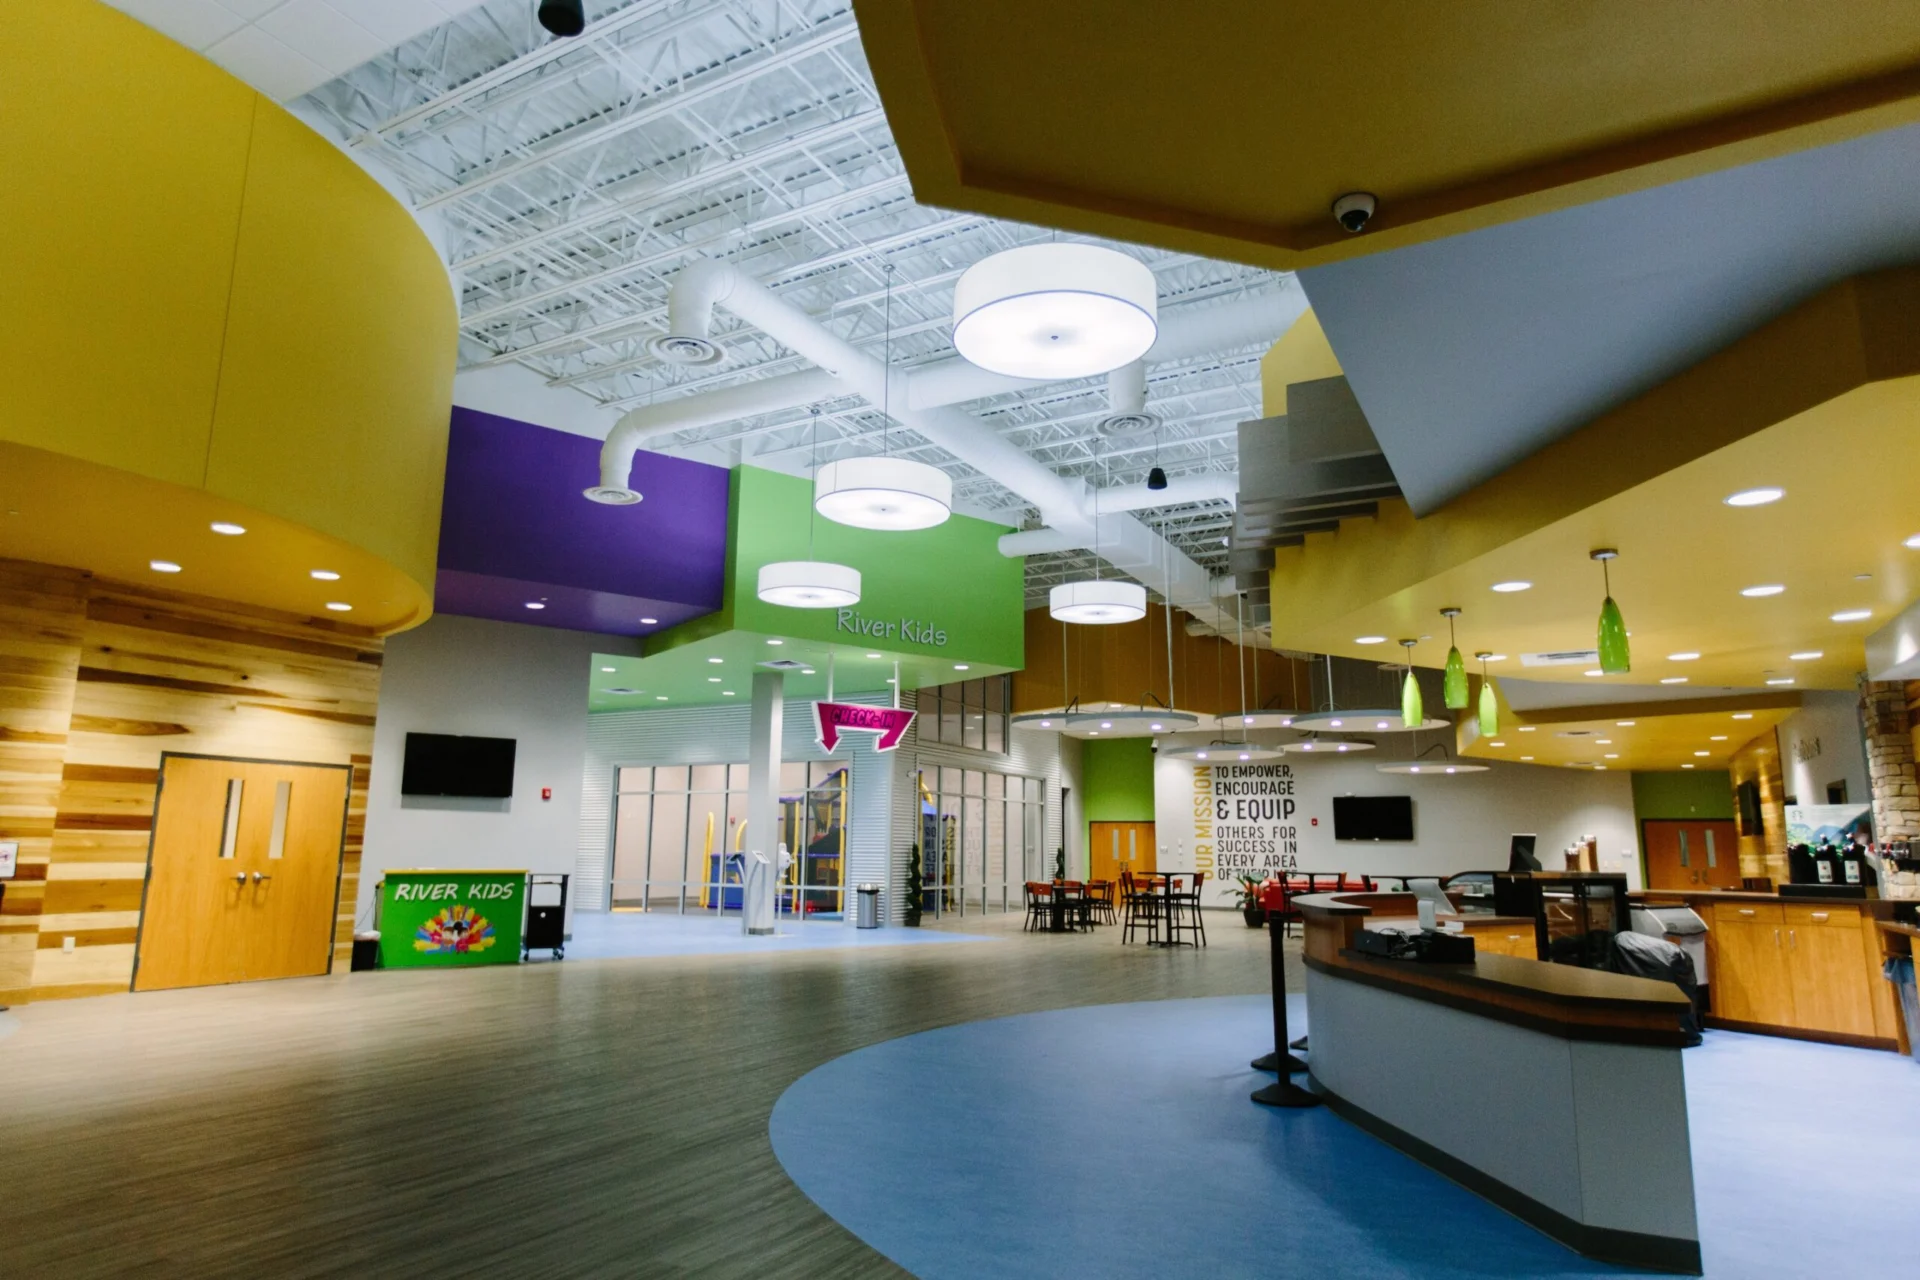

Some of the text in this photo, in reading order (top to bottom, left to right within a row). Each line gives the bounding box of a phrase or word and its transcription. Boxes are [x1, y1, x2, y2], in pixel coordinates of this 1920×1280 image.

[837, 606, 947, 646] River Kids
[831, 707, 896, 729] CHECK-IN
[1215, 764, 1294, 779] TO EMPOWER,
[1215, 781, 1295, 796] ENCOURAGE
[1194, 766, 1212, 838] MISSION
[1216, 799, 1295, 823] & EQUIP
[1217, 826, 1297, 839] OTHERS FOR
[1217, 840, 1297, 853] SUCCESS IN
[1217, 854, 1298, 868] EVERY AREA
[1217, 868, 1232, 881] OF
[394, 882, 515, 901] RIVER KIDS
